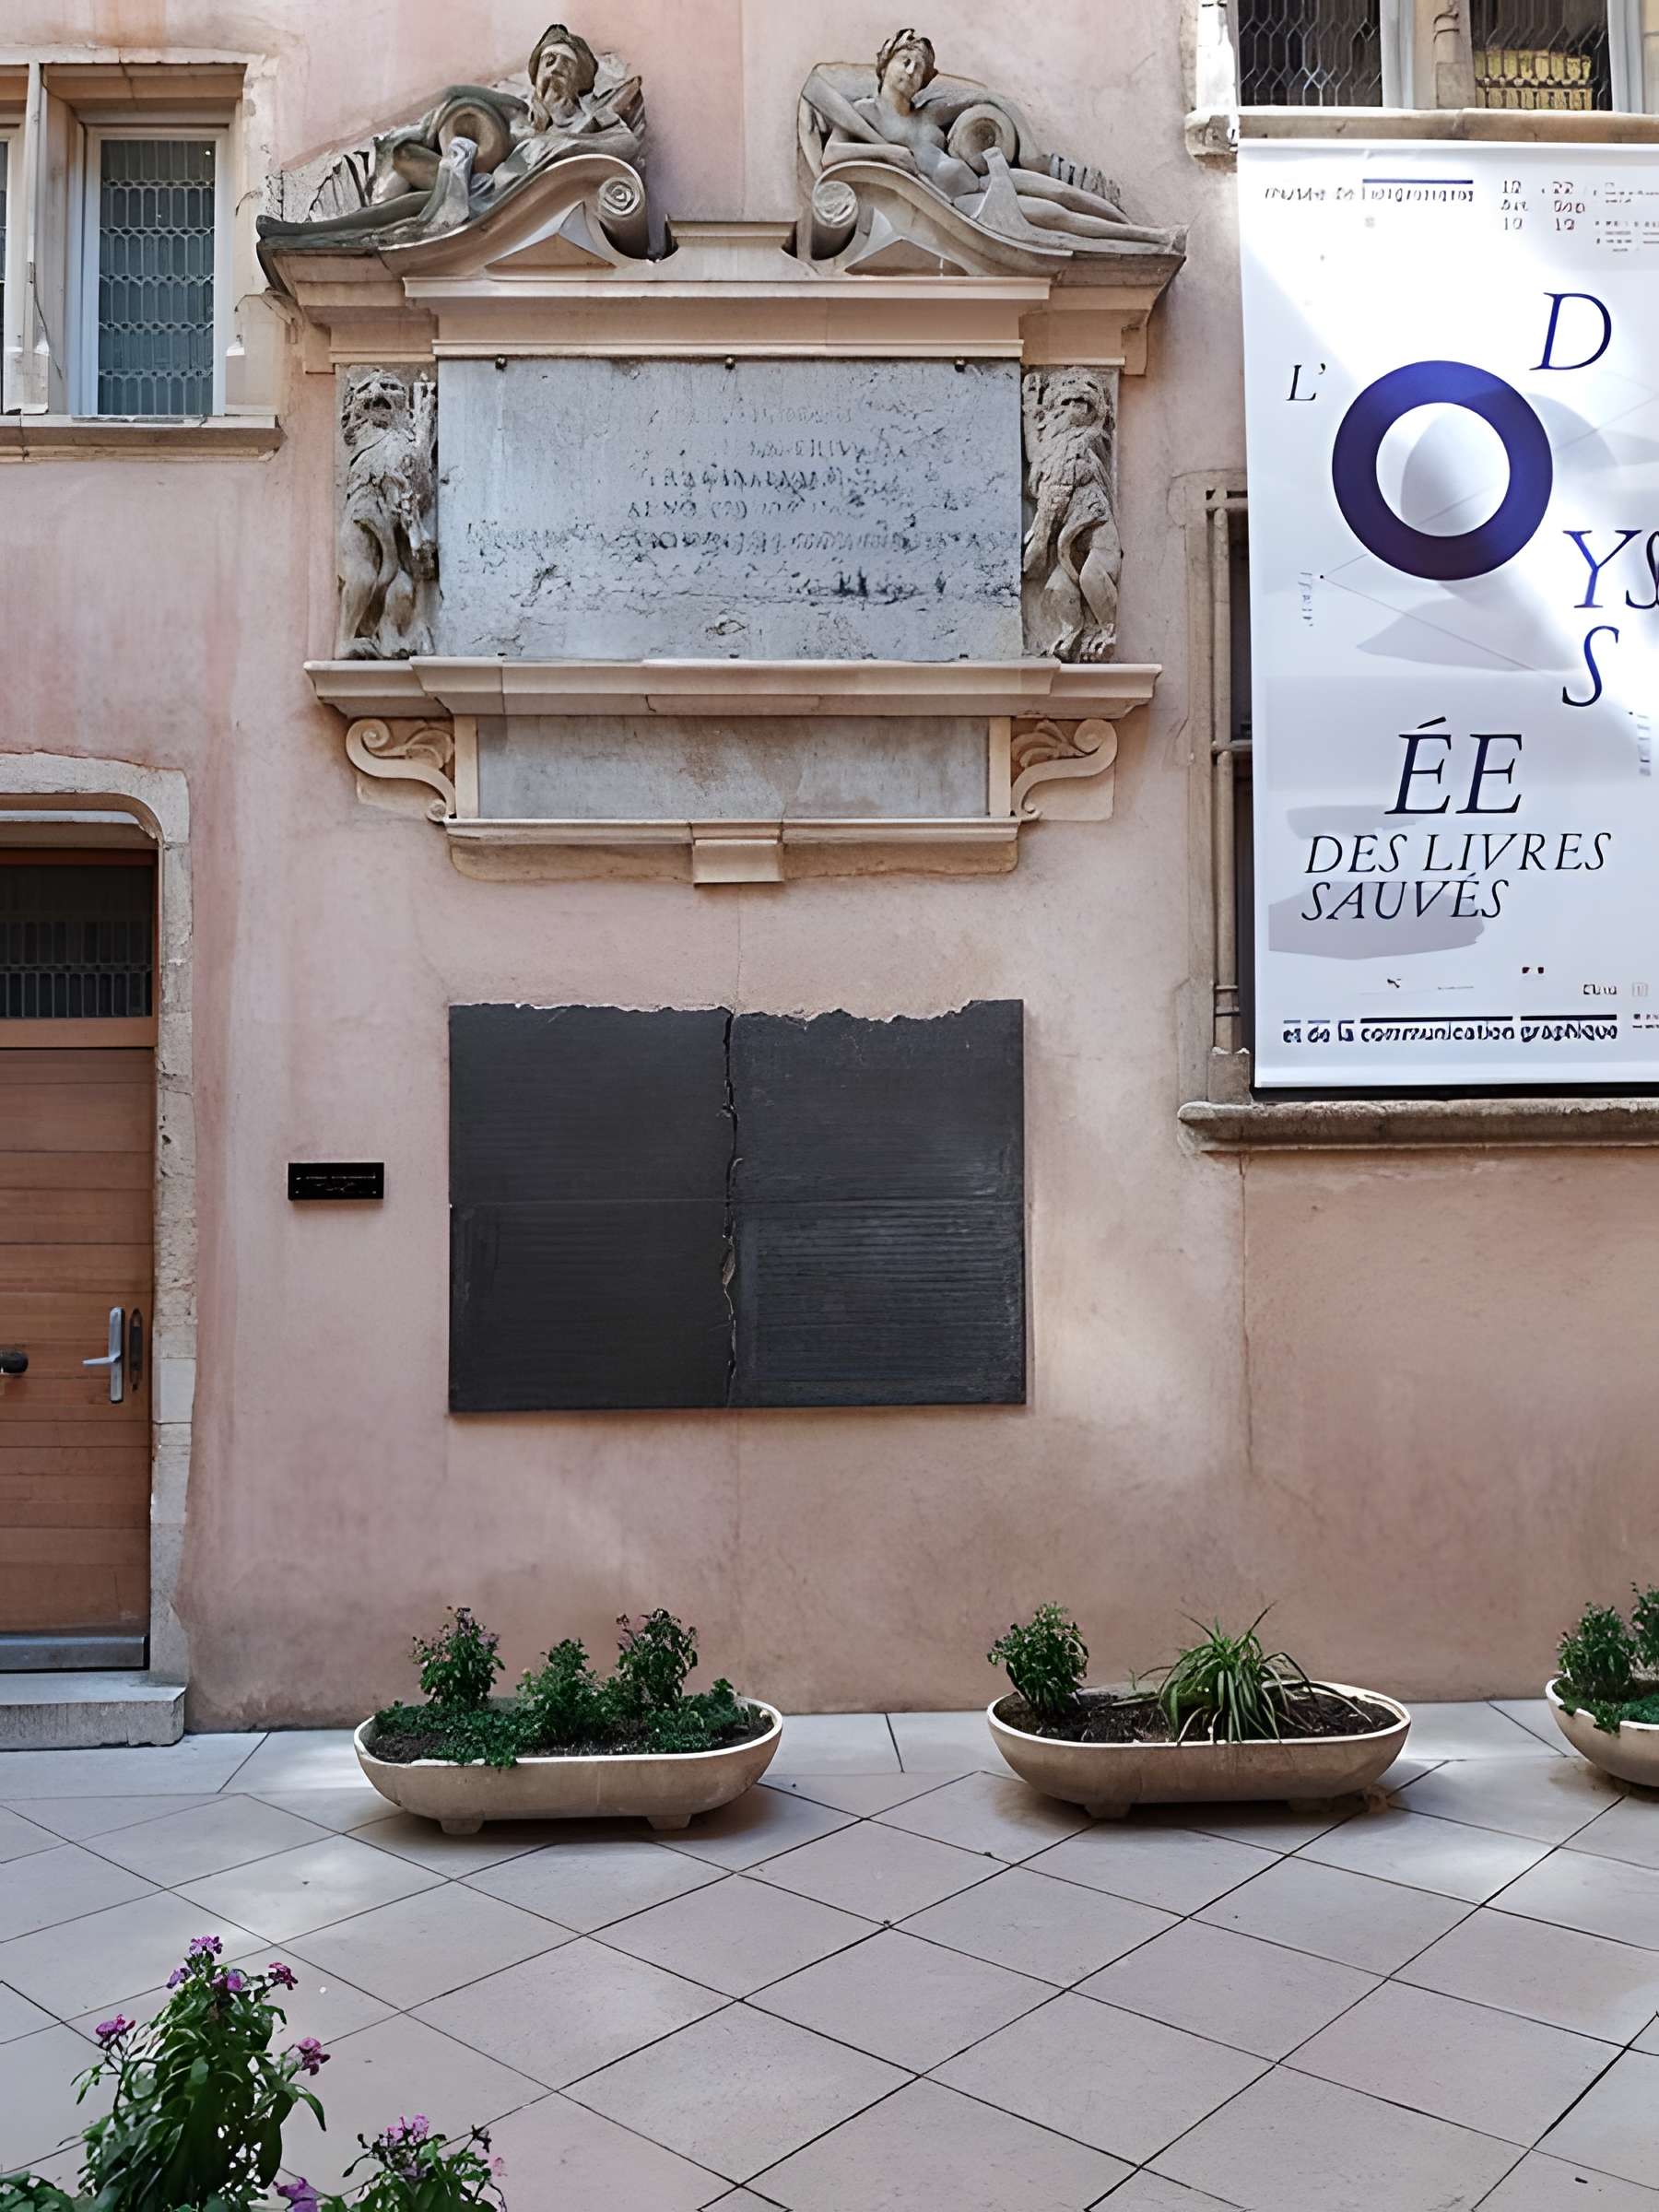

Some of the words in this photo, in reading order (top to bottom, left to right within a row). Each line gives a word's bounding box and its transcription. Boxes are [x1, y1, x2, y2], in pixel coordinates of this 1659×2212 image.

[1529, 291, 1612, 371] D
[1562, 625, 1619, 707] S
[1384, 716, 1522, 814] ÉE
[1304, 834, 1408, 874] DES
[1423, 832, 1612, 872] LIVRES
[1301, 872, 1510, 921] SAUVÉS
